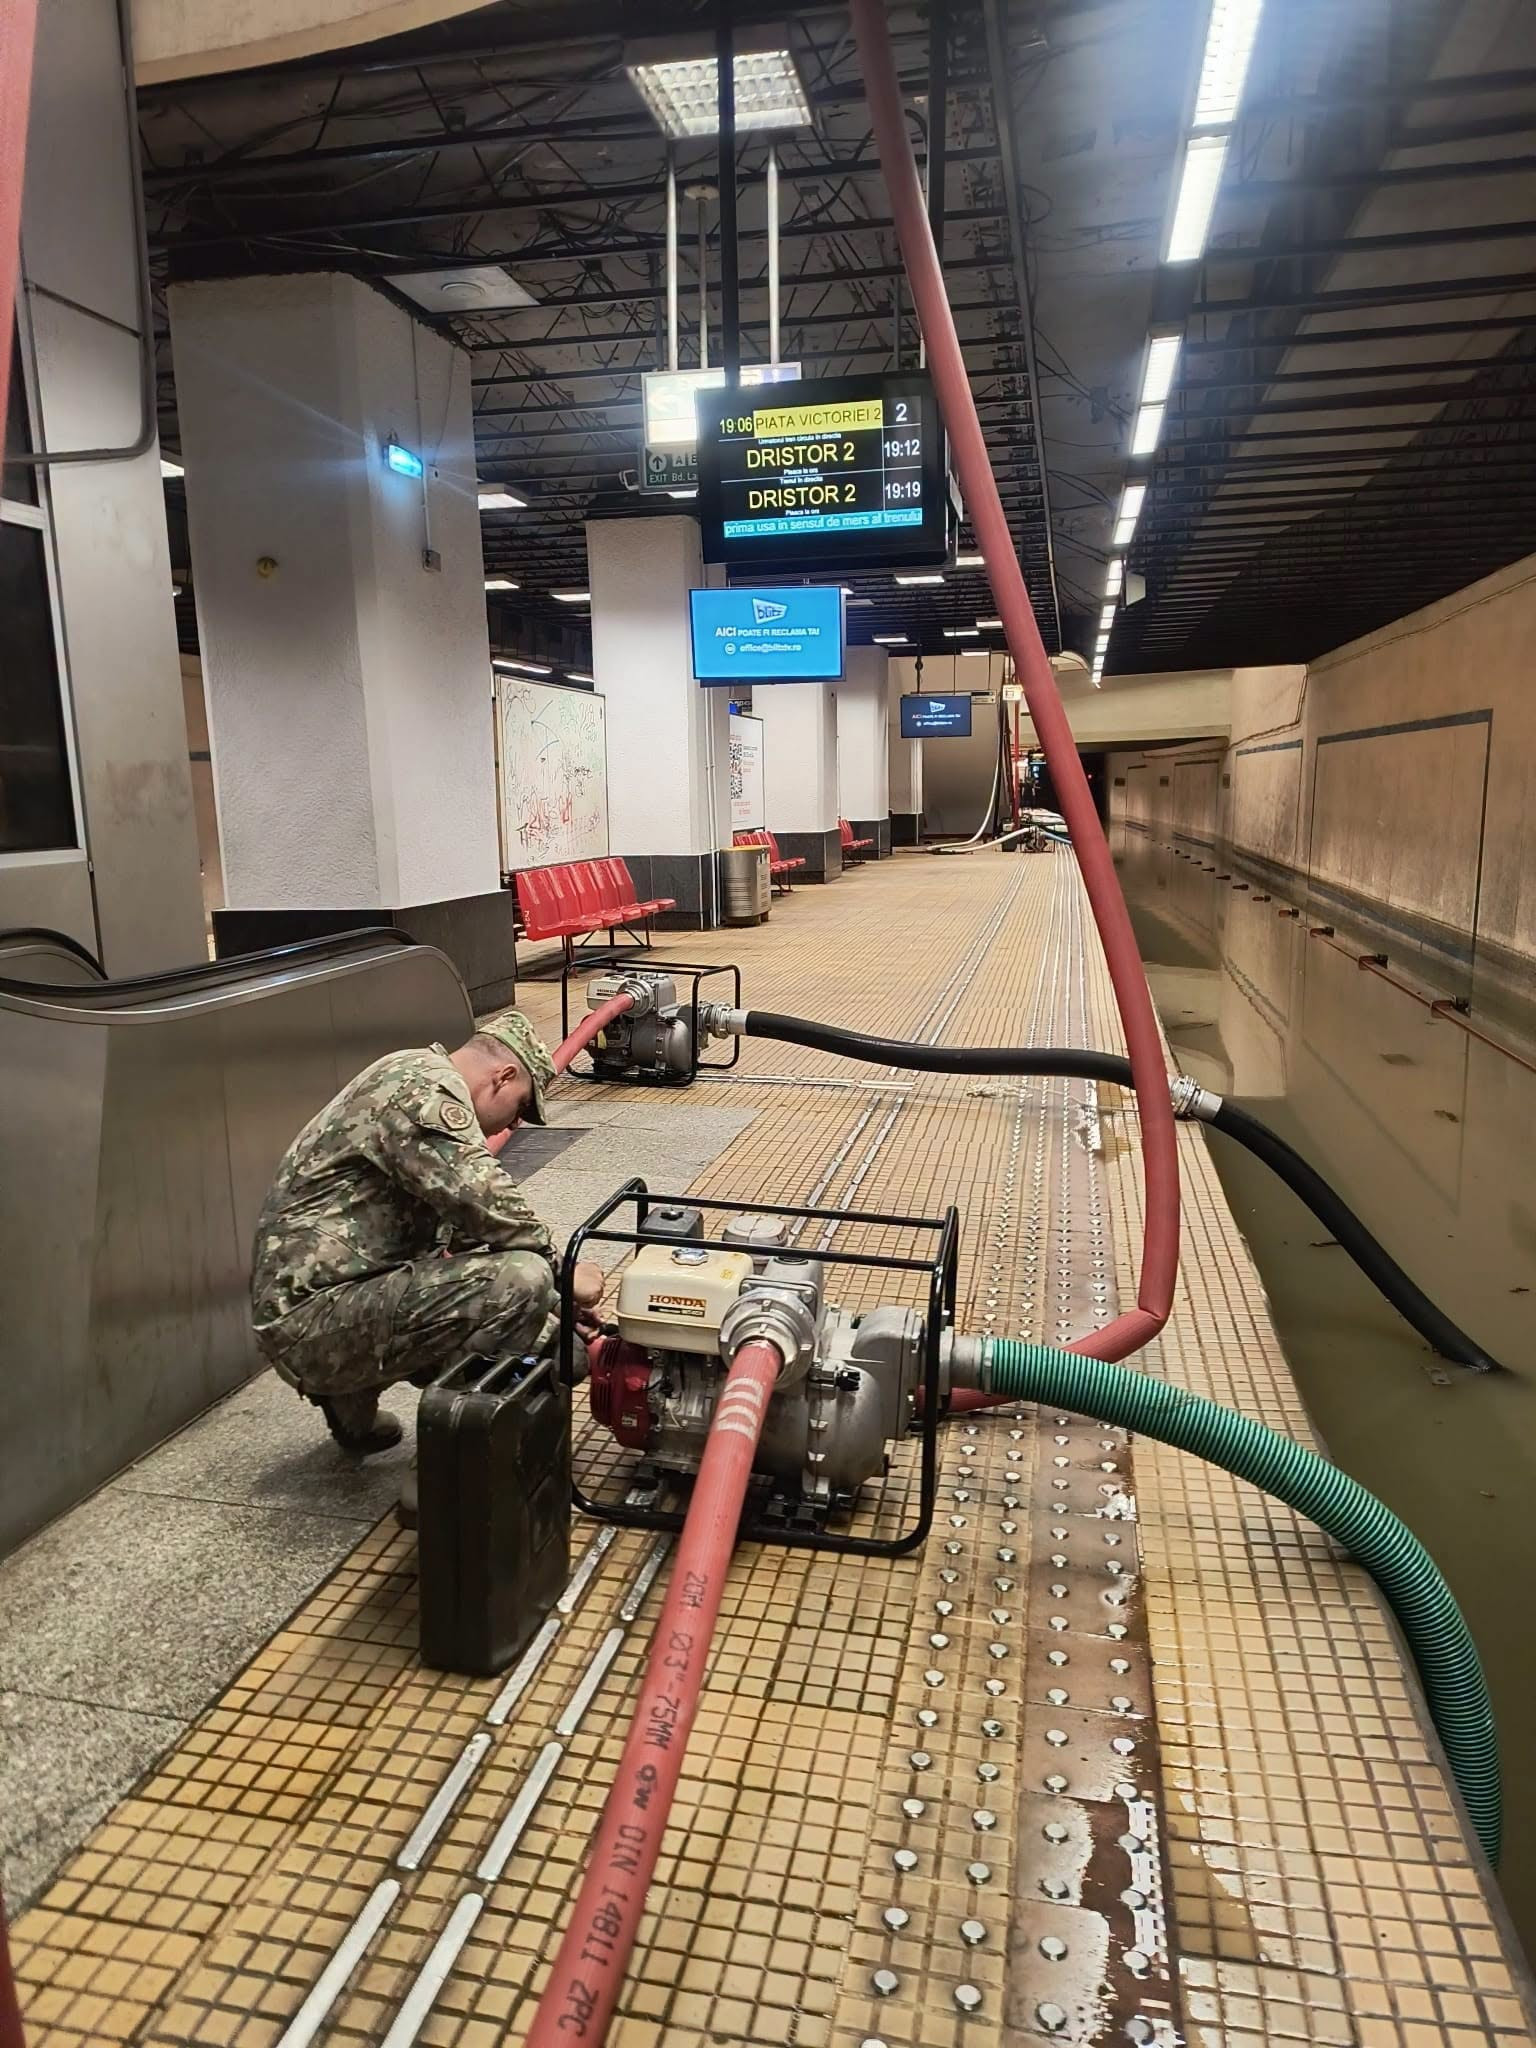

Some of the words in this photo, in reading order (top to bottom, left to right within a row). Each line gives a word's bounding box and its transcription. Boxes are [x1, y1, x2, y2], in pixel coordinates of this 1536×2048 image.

[720, 417, 752, 434] 19:06
[756, 415, 796, 430] PIATA
[799, 409, 870, 426] VICTORIEI
[874, 407, 881, 420] 2
[895, 403, 907, 422] 2
[746, 443, 838, 468] DRISTOR
[843, 442, 855, 461] 2
[884, 439, 920, 457] 19:12
[649, 473, 668, 483] EXIT
[748, 485, 839, 509] DRISTOR
[844, 483, 856, 502] 2
[885, 481, 920, 499] 19:19
[725, 523, 754, 537] prima
[757, 522, 776, 533] usa
[778, 520, 788, 531] in
[790, 517, 824, 530] sensul
[826, 515, 841, 527] de
[842, 515, 869, 526] mers
[871, 512, 882, 524] al
[715, 627, 736, 637] AICI
[737, 629, 762, 637] POATE
[649, 1294, 706, 1308] HONDA
[609, 1824, 647, 1876] DIN
[580, 1885, 629, 1967] 14811
